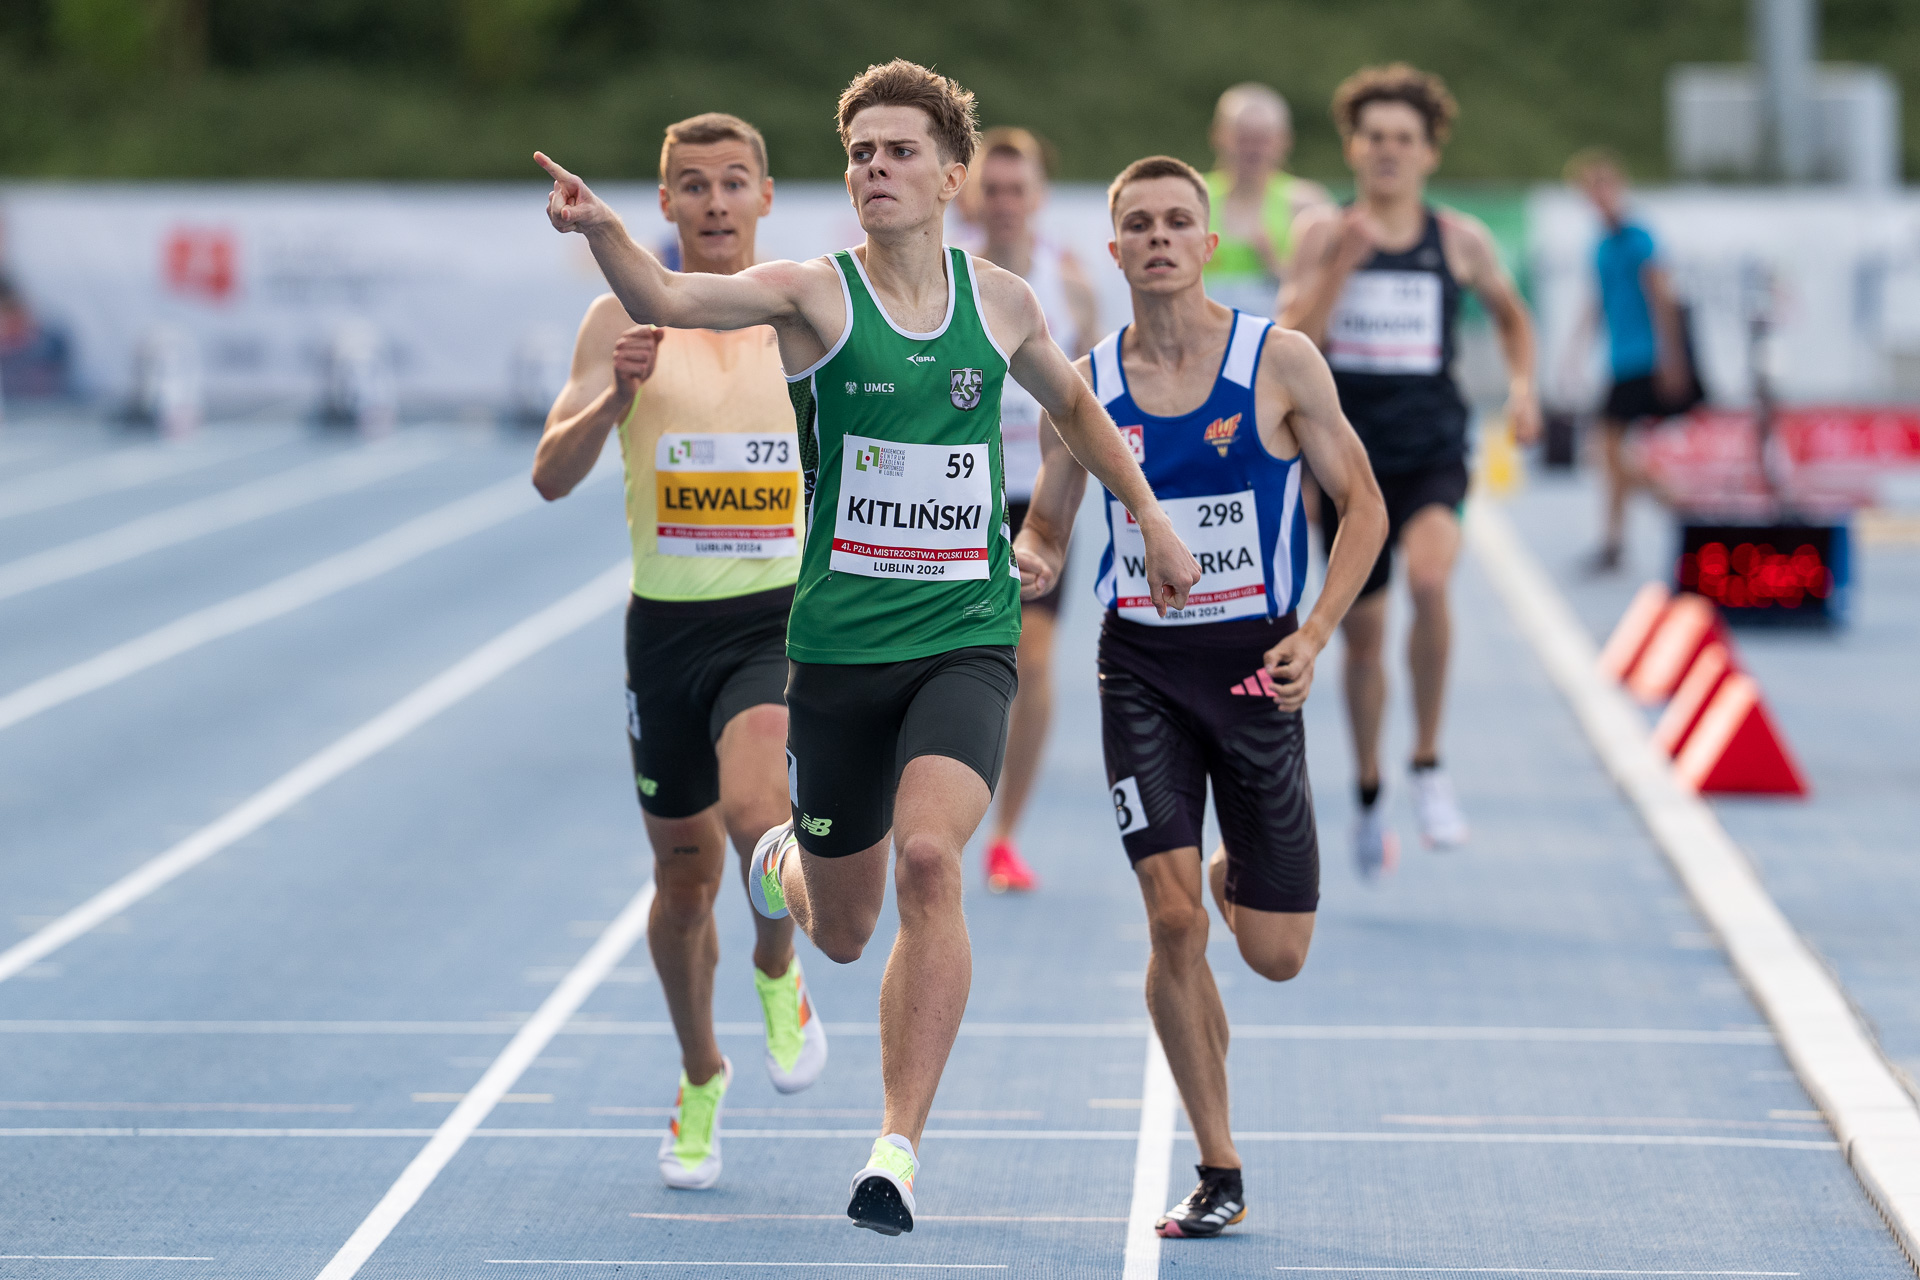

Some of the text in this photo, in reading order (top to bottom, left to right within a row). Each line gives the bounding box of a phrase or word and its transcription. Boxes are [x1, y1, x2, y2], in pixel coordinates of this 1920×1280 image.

[864, 382, 895, 393] UMCS
[746, 440, 789, 464] 373
[945, 452, 975, 479] 59
[665, 487, 791, 511] LEWALSKI
[847, 495, 982, 531] KITLIŃSKI
[1197, 500, 1244, 528] 298
[841, 543, 980, 560] 41. PZLA MISTRZOSTWA POLSKI U23
[1122, 546, 1254, 578] WRKA
[873, 562, 945, 575] LUBLIN 2024
[1160, 605, 1226, 619] UBLIN 2024
